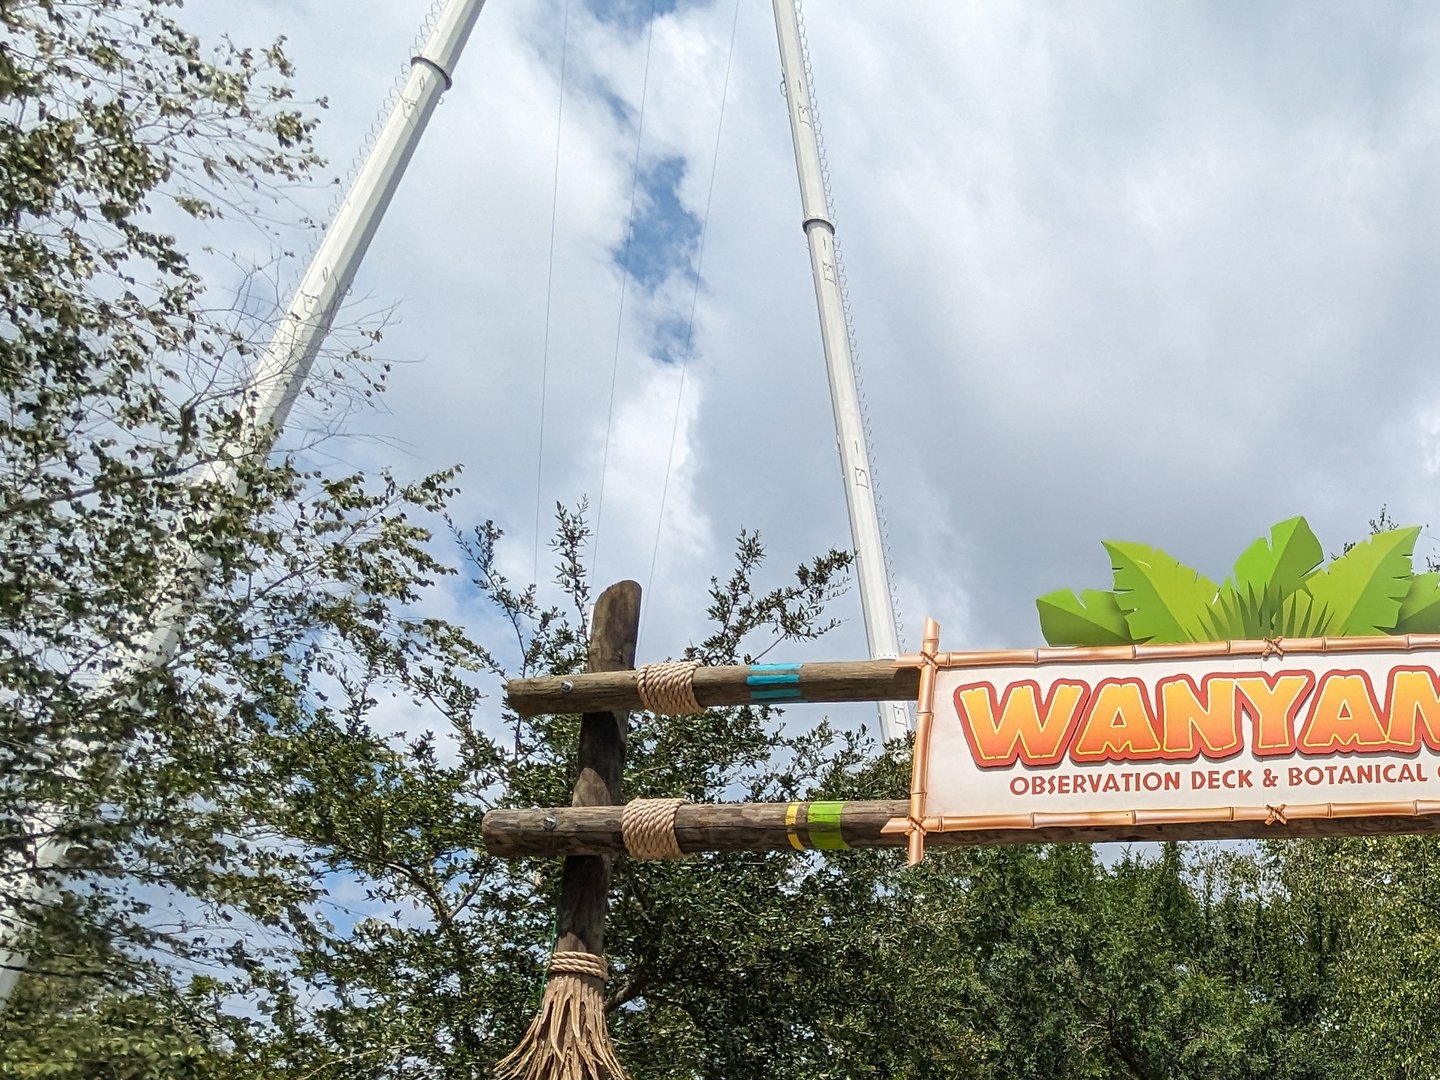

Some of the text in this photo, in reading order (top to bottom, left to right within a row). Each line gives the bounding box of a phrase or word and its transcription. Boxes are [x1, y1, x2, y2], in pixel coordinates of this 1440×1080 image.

[1009, 771, 1181, 796] OBSERVATION
[1191, 769, 1254, 790] DECK
[1262, 768, 1279, 788] &
[1288, 763, 1428, 786] BOTANICAL
